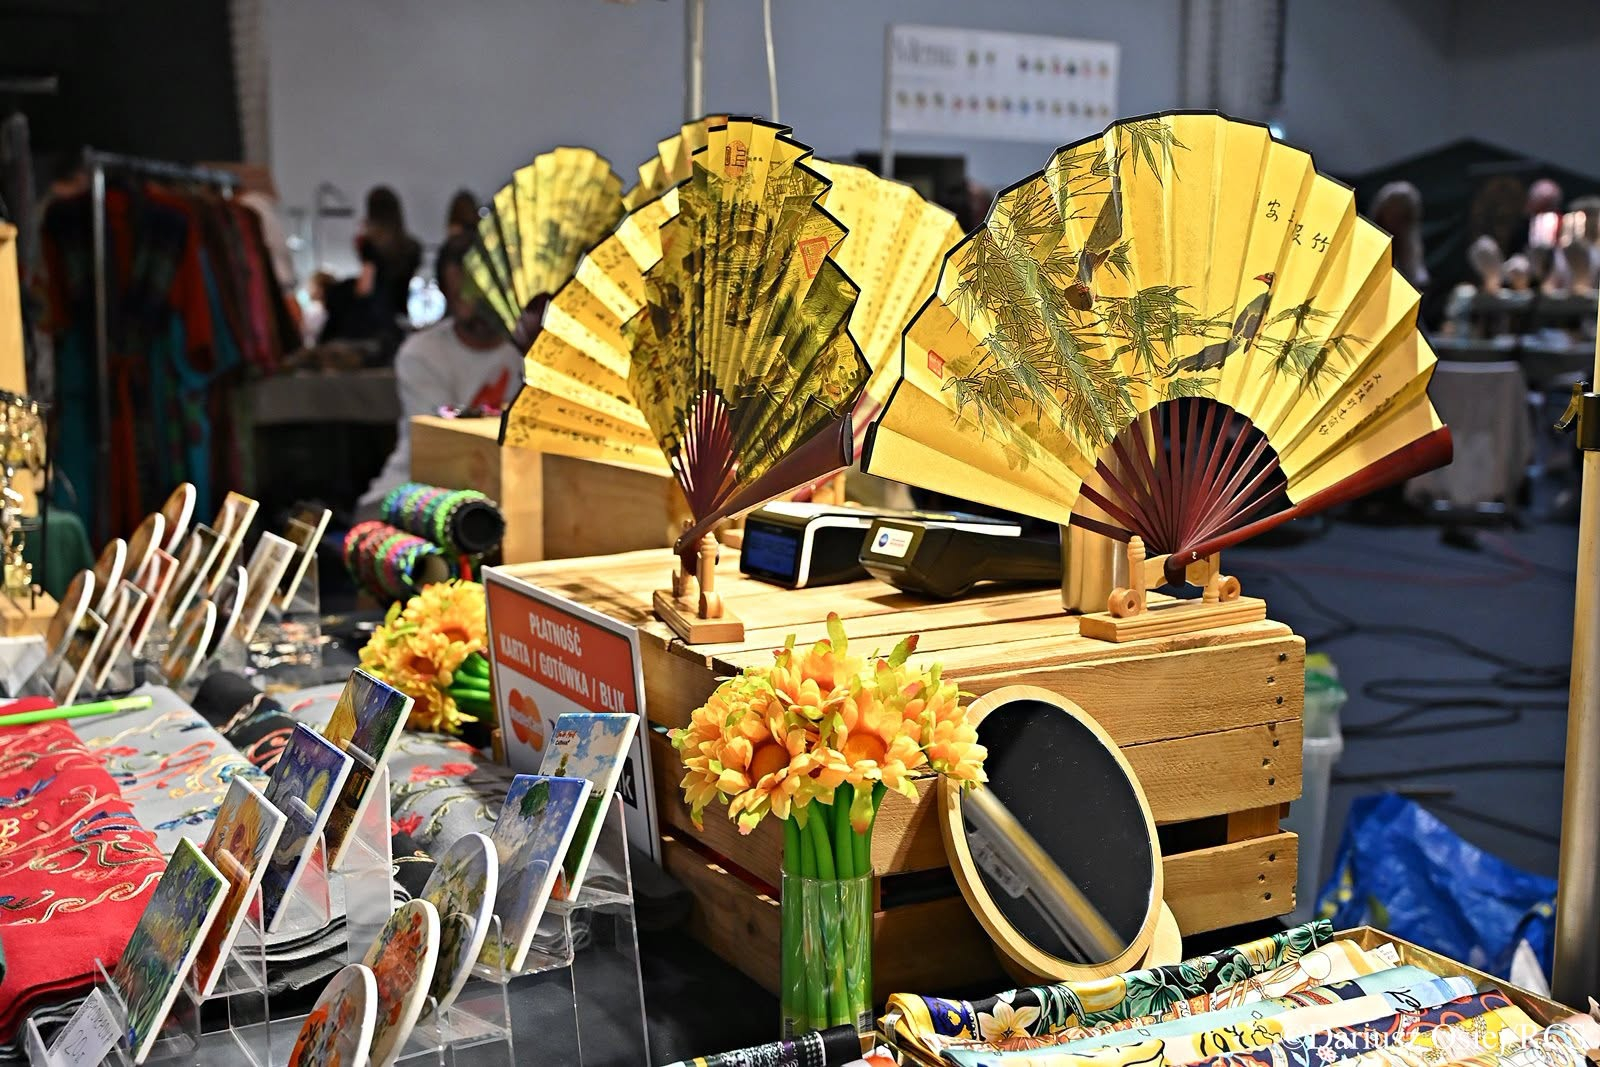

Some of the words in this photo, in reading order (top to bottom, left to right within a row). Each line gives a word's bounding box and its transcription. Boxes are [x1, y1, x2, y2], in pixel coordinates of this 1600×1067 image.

[529, 611, 582, 657] PŁATNOŚĆ
[500, 633, 531, 668] KARTA
[532, 648, 537, 672] /
[539, 652, 590, 698] GOTÓWKA
[592, 677, 597, 703] /
[599, 680, 626, 714] BLIK
